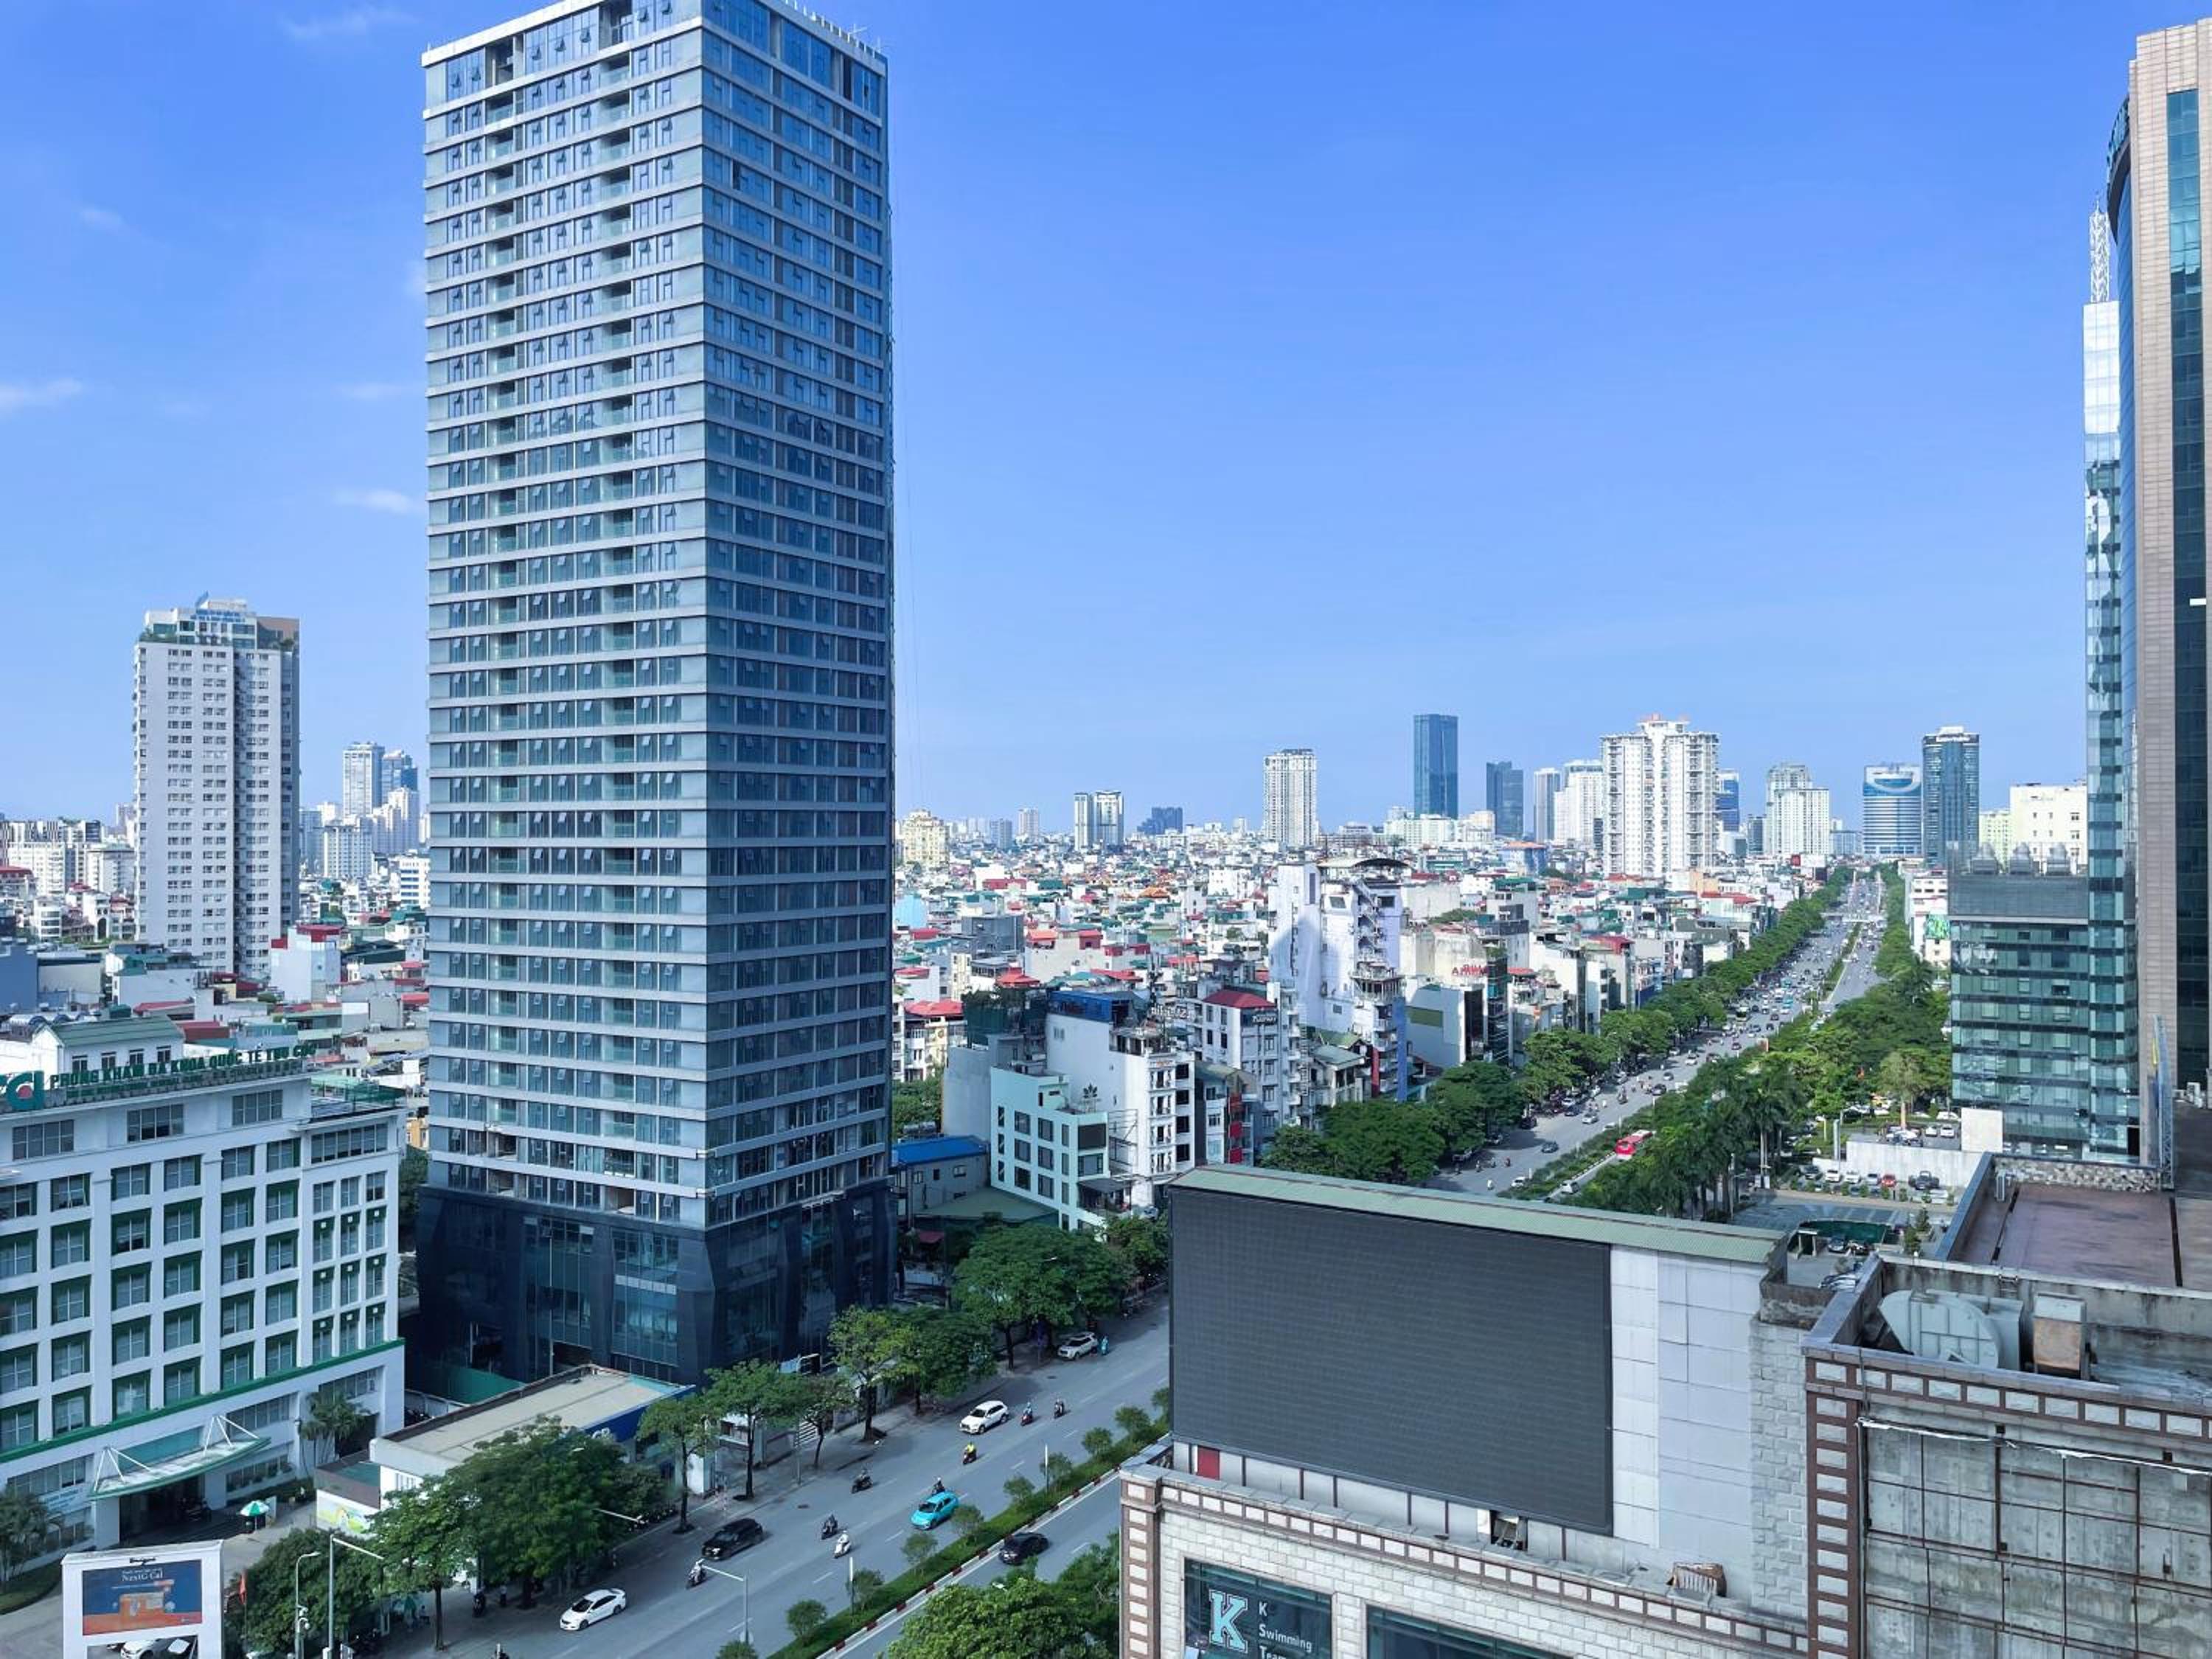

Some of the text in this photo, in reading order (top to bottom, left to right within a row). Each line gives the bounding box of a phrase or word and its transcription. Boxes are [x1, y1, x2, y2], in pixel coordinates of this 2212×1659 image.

[1209, 1589, 1248, 1654] K
[1259, 1601, 1267, 1617] K
[1259, 1624, 1312, 1652] Swimming
